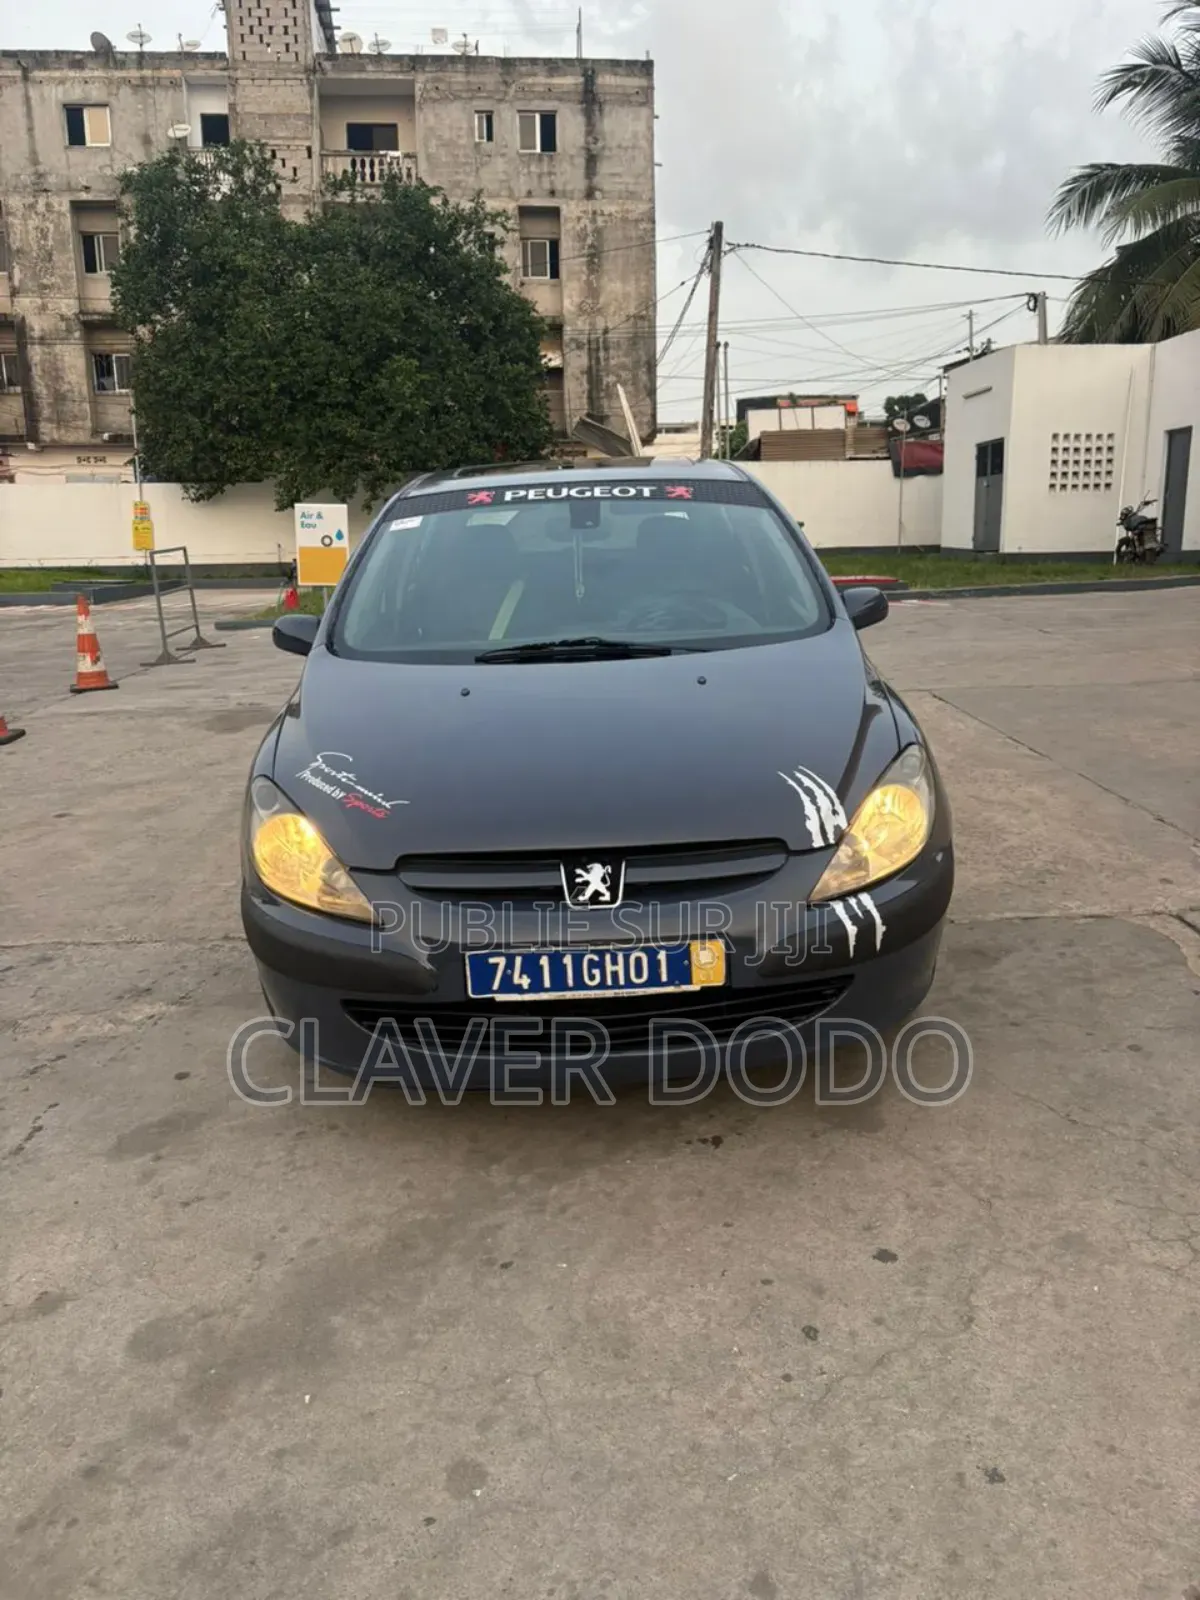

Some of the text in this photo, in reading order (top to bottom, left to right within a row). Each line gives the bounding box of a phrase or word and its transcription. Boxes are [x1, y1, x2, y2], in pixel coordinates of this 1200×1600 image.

[504, 486, 657, 501] PEUGEOT
[300, 512, 313, 520] Air
[488, 950, 669, 991] 7411GH01
